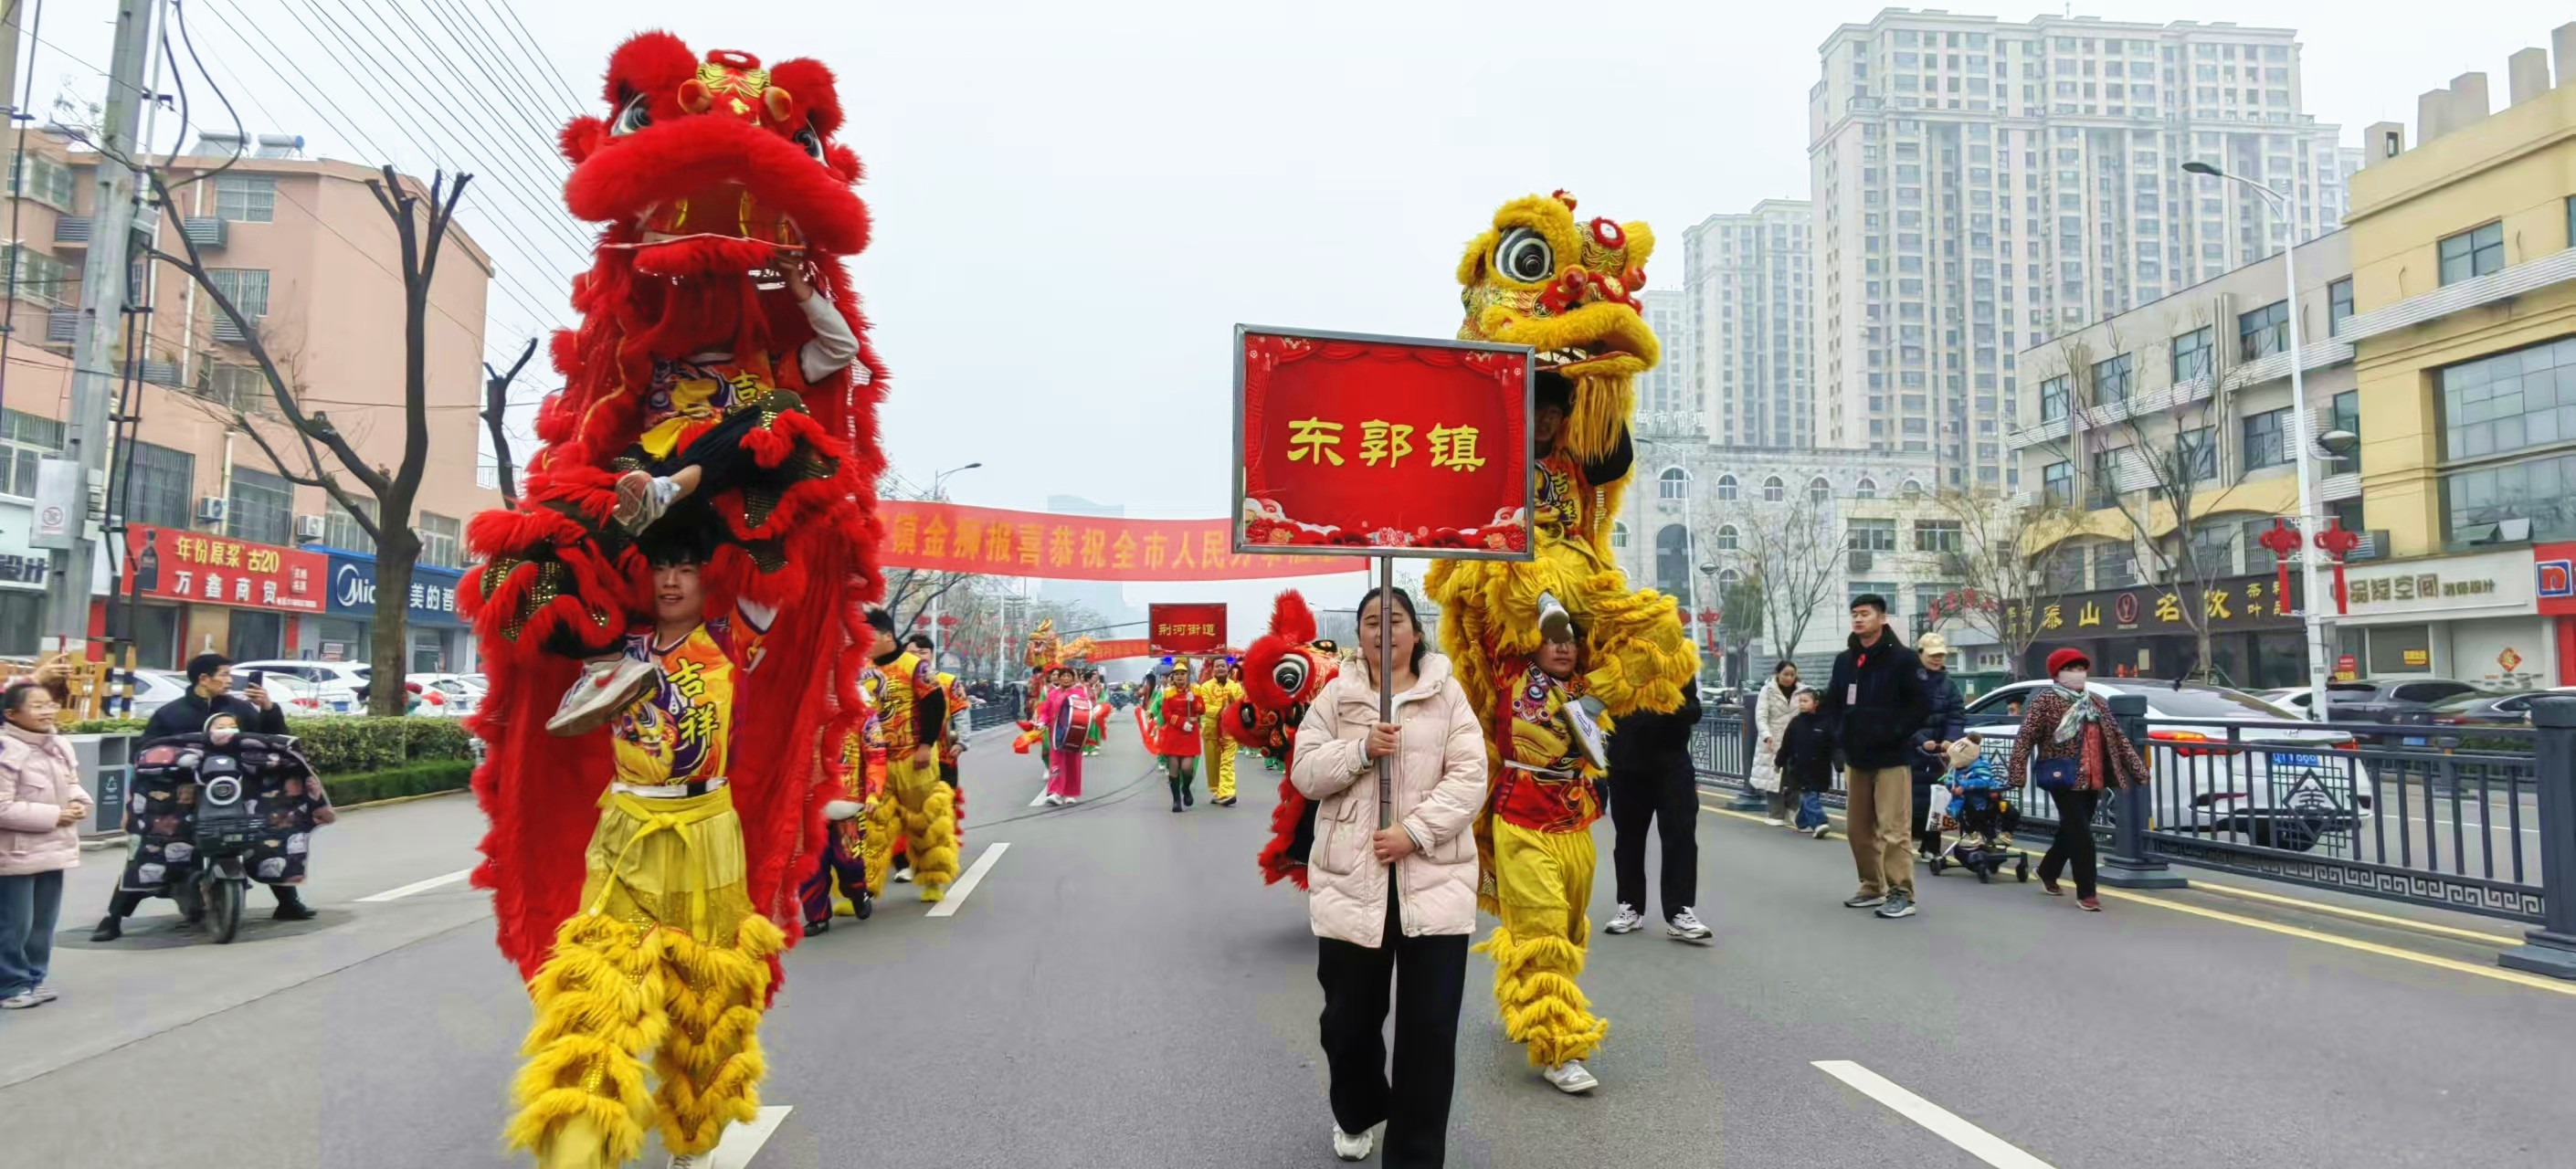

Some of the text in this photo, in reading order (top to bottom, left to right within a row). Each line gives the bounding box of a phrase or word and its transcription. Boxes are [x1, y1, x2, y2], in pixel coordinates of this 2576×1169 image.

[1286, 416, 1486, 472] 东郭镇
[175, 536, 280, 574] 年份原浆 古20
[174, 570, 278, 605] 万鑫商贸
[1158, 624, 1216, 637] 荆河街道
[2043, 600, 2100, 629] 泰山
[666, 658, 719, 747] 吉祥
